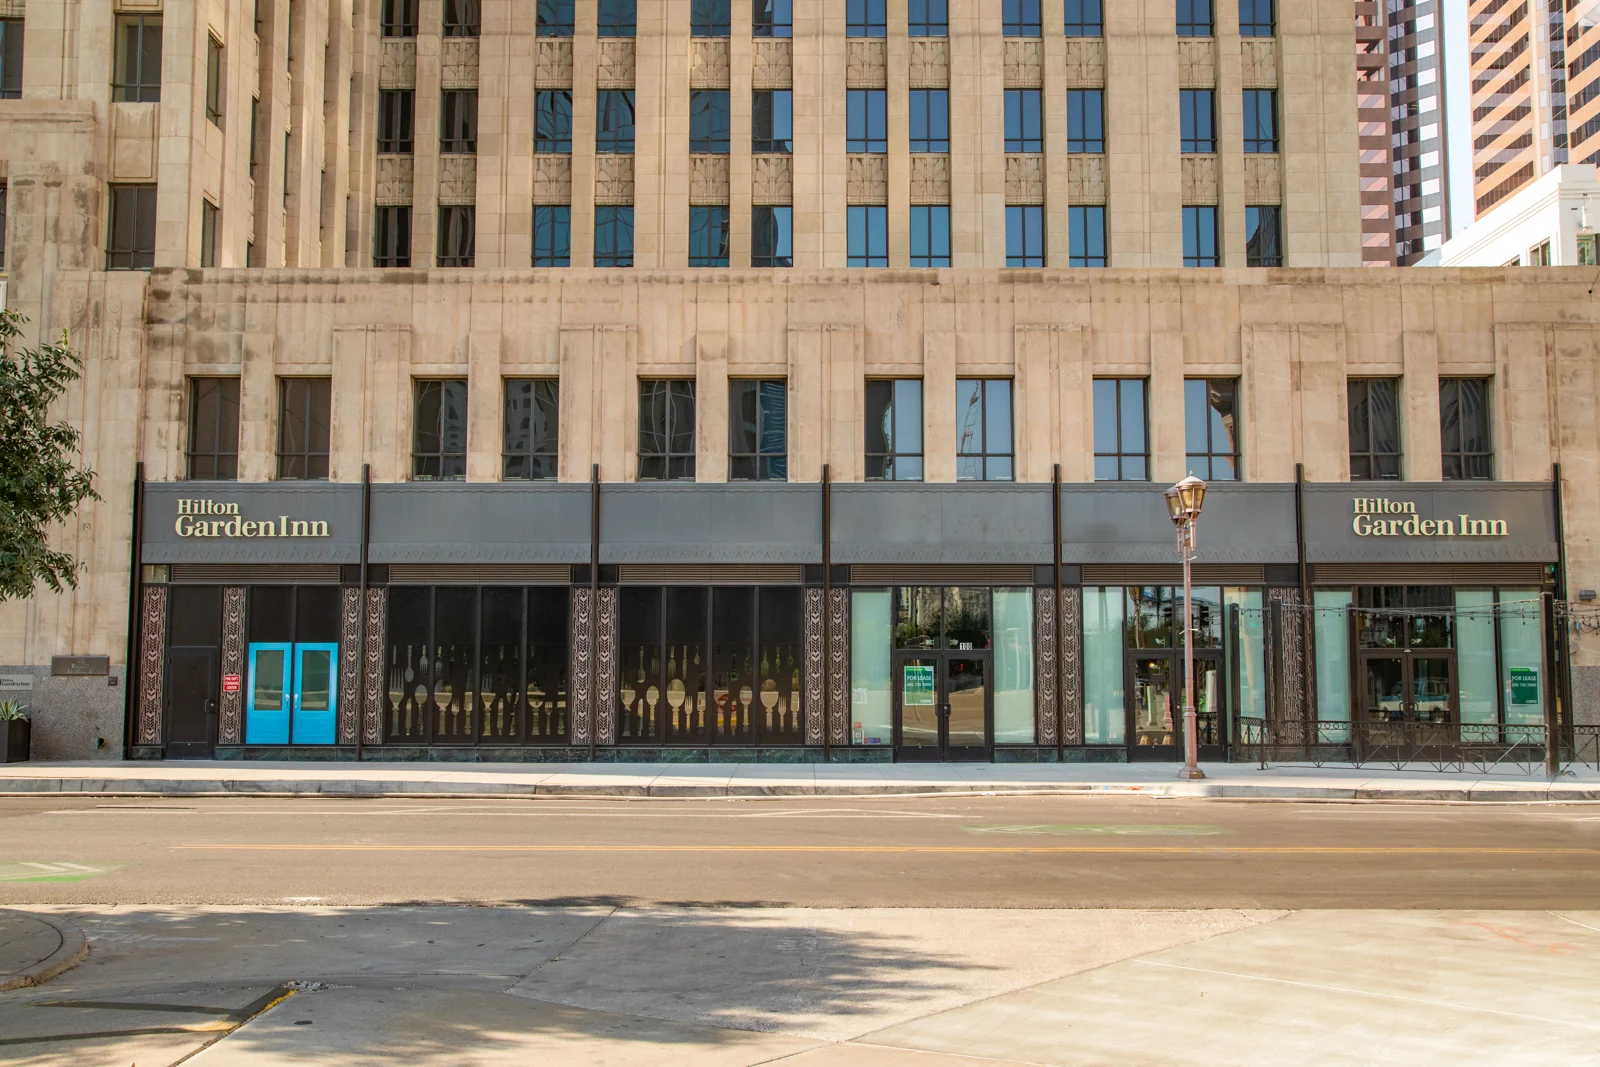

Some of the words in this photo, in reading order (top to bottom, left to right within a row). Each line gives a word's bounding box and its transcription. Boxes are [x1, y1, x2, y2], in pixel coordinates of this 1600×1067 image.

[177, 498, 239, 515] Hilton
[1352, 497, 1416, 514] Hilton
[174, 515, 277, 537] Garden
[278, 515, 330, 537] Inn
[1352, 514, 1456, 536] Garden
[1458, 514, 1509, 536] Inn
[960, 642, 973, 650] 100
